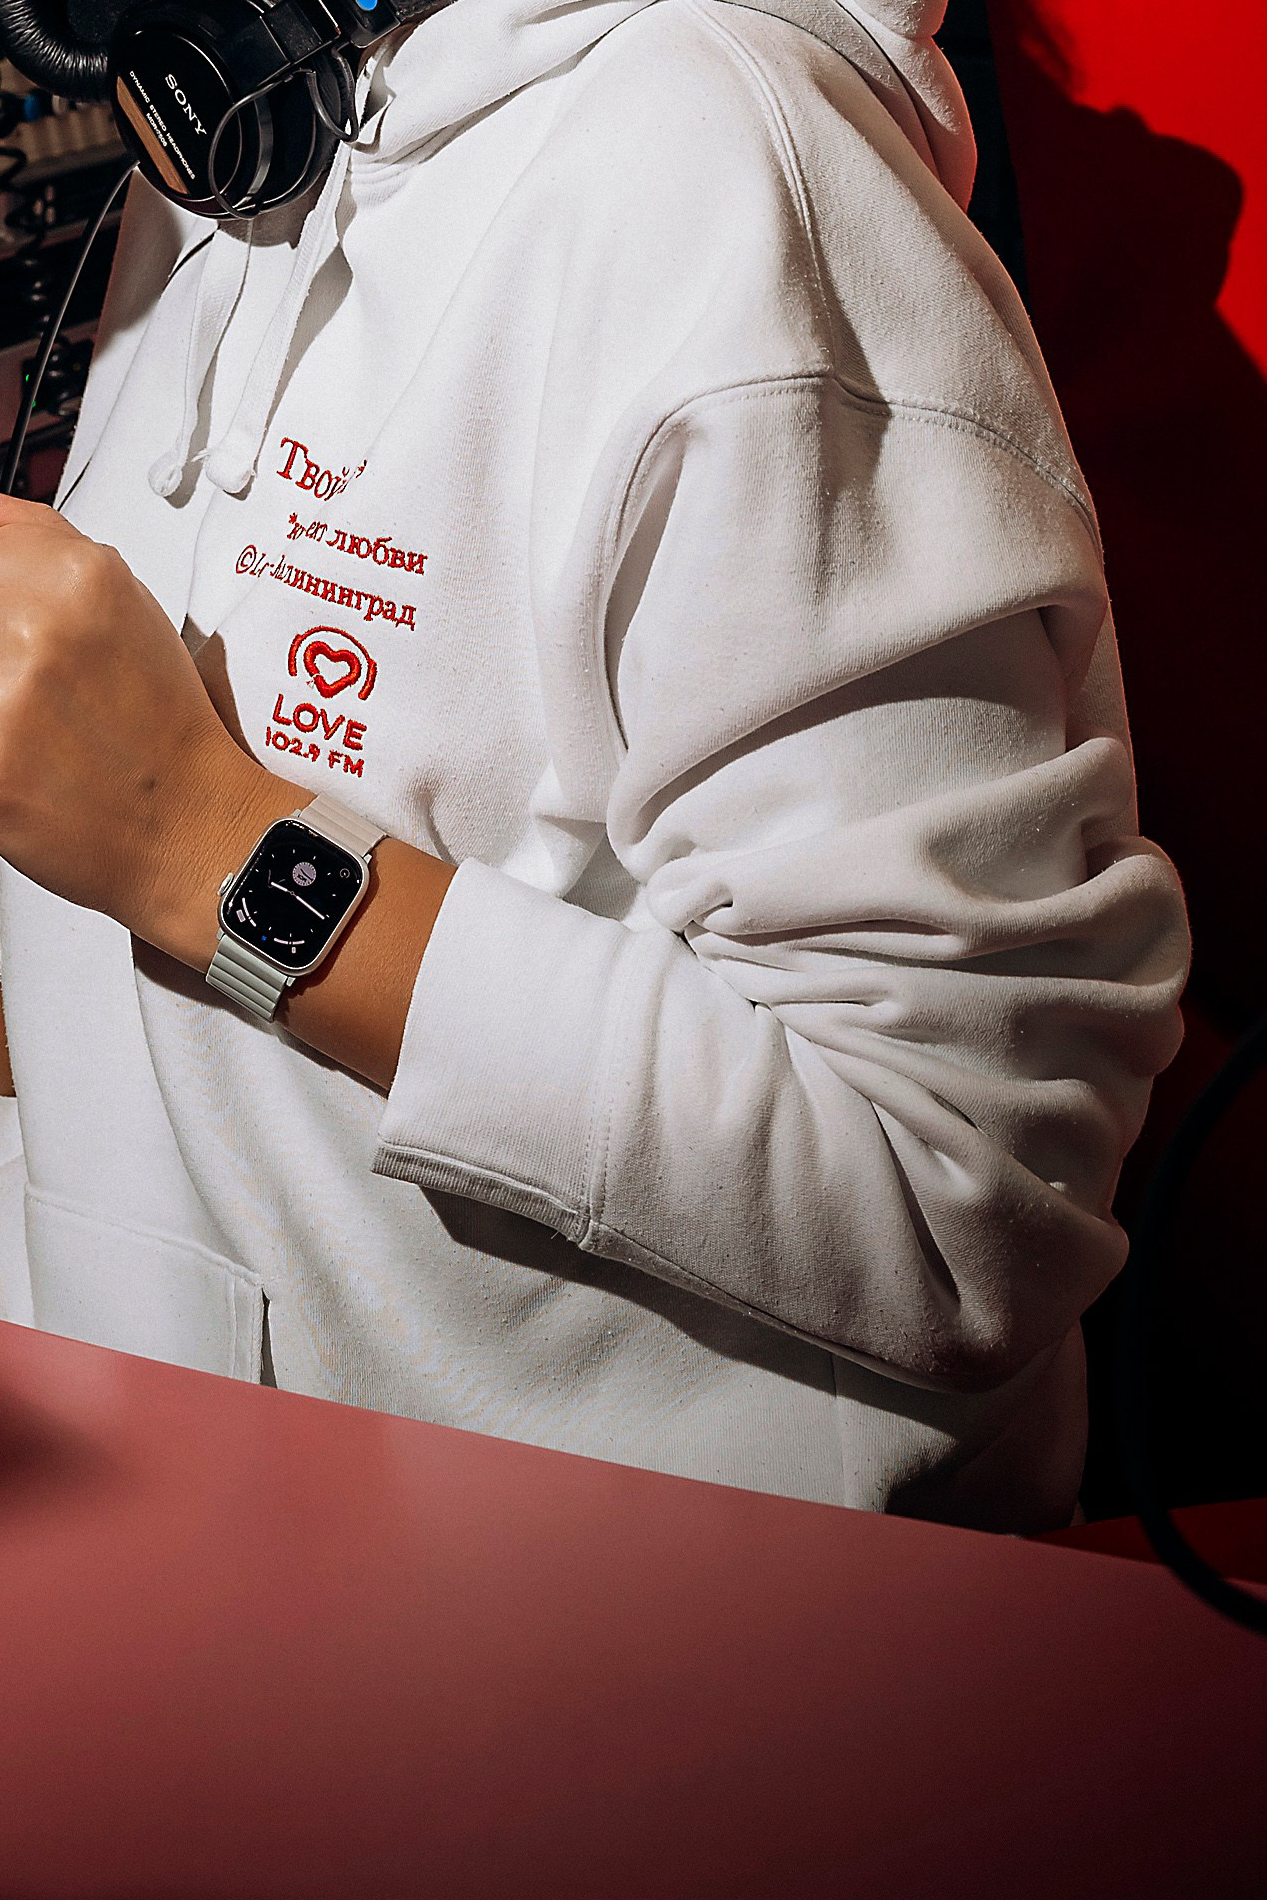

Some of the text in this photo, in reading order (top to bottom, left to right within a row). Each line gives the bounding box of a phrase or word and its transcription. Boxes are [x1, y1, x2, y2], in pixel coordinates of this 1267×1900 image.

[129, 70, 196, 180] DYNAMIC STEREO HEADPHONES
[165, 74, 207, 135] SONY
[326, 536, 427, 575] любви
[272, 693, 367, 750] LOVE
[328, 750, 365, 778] FM
